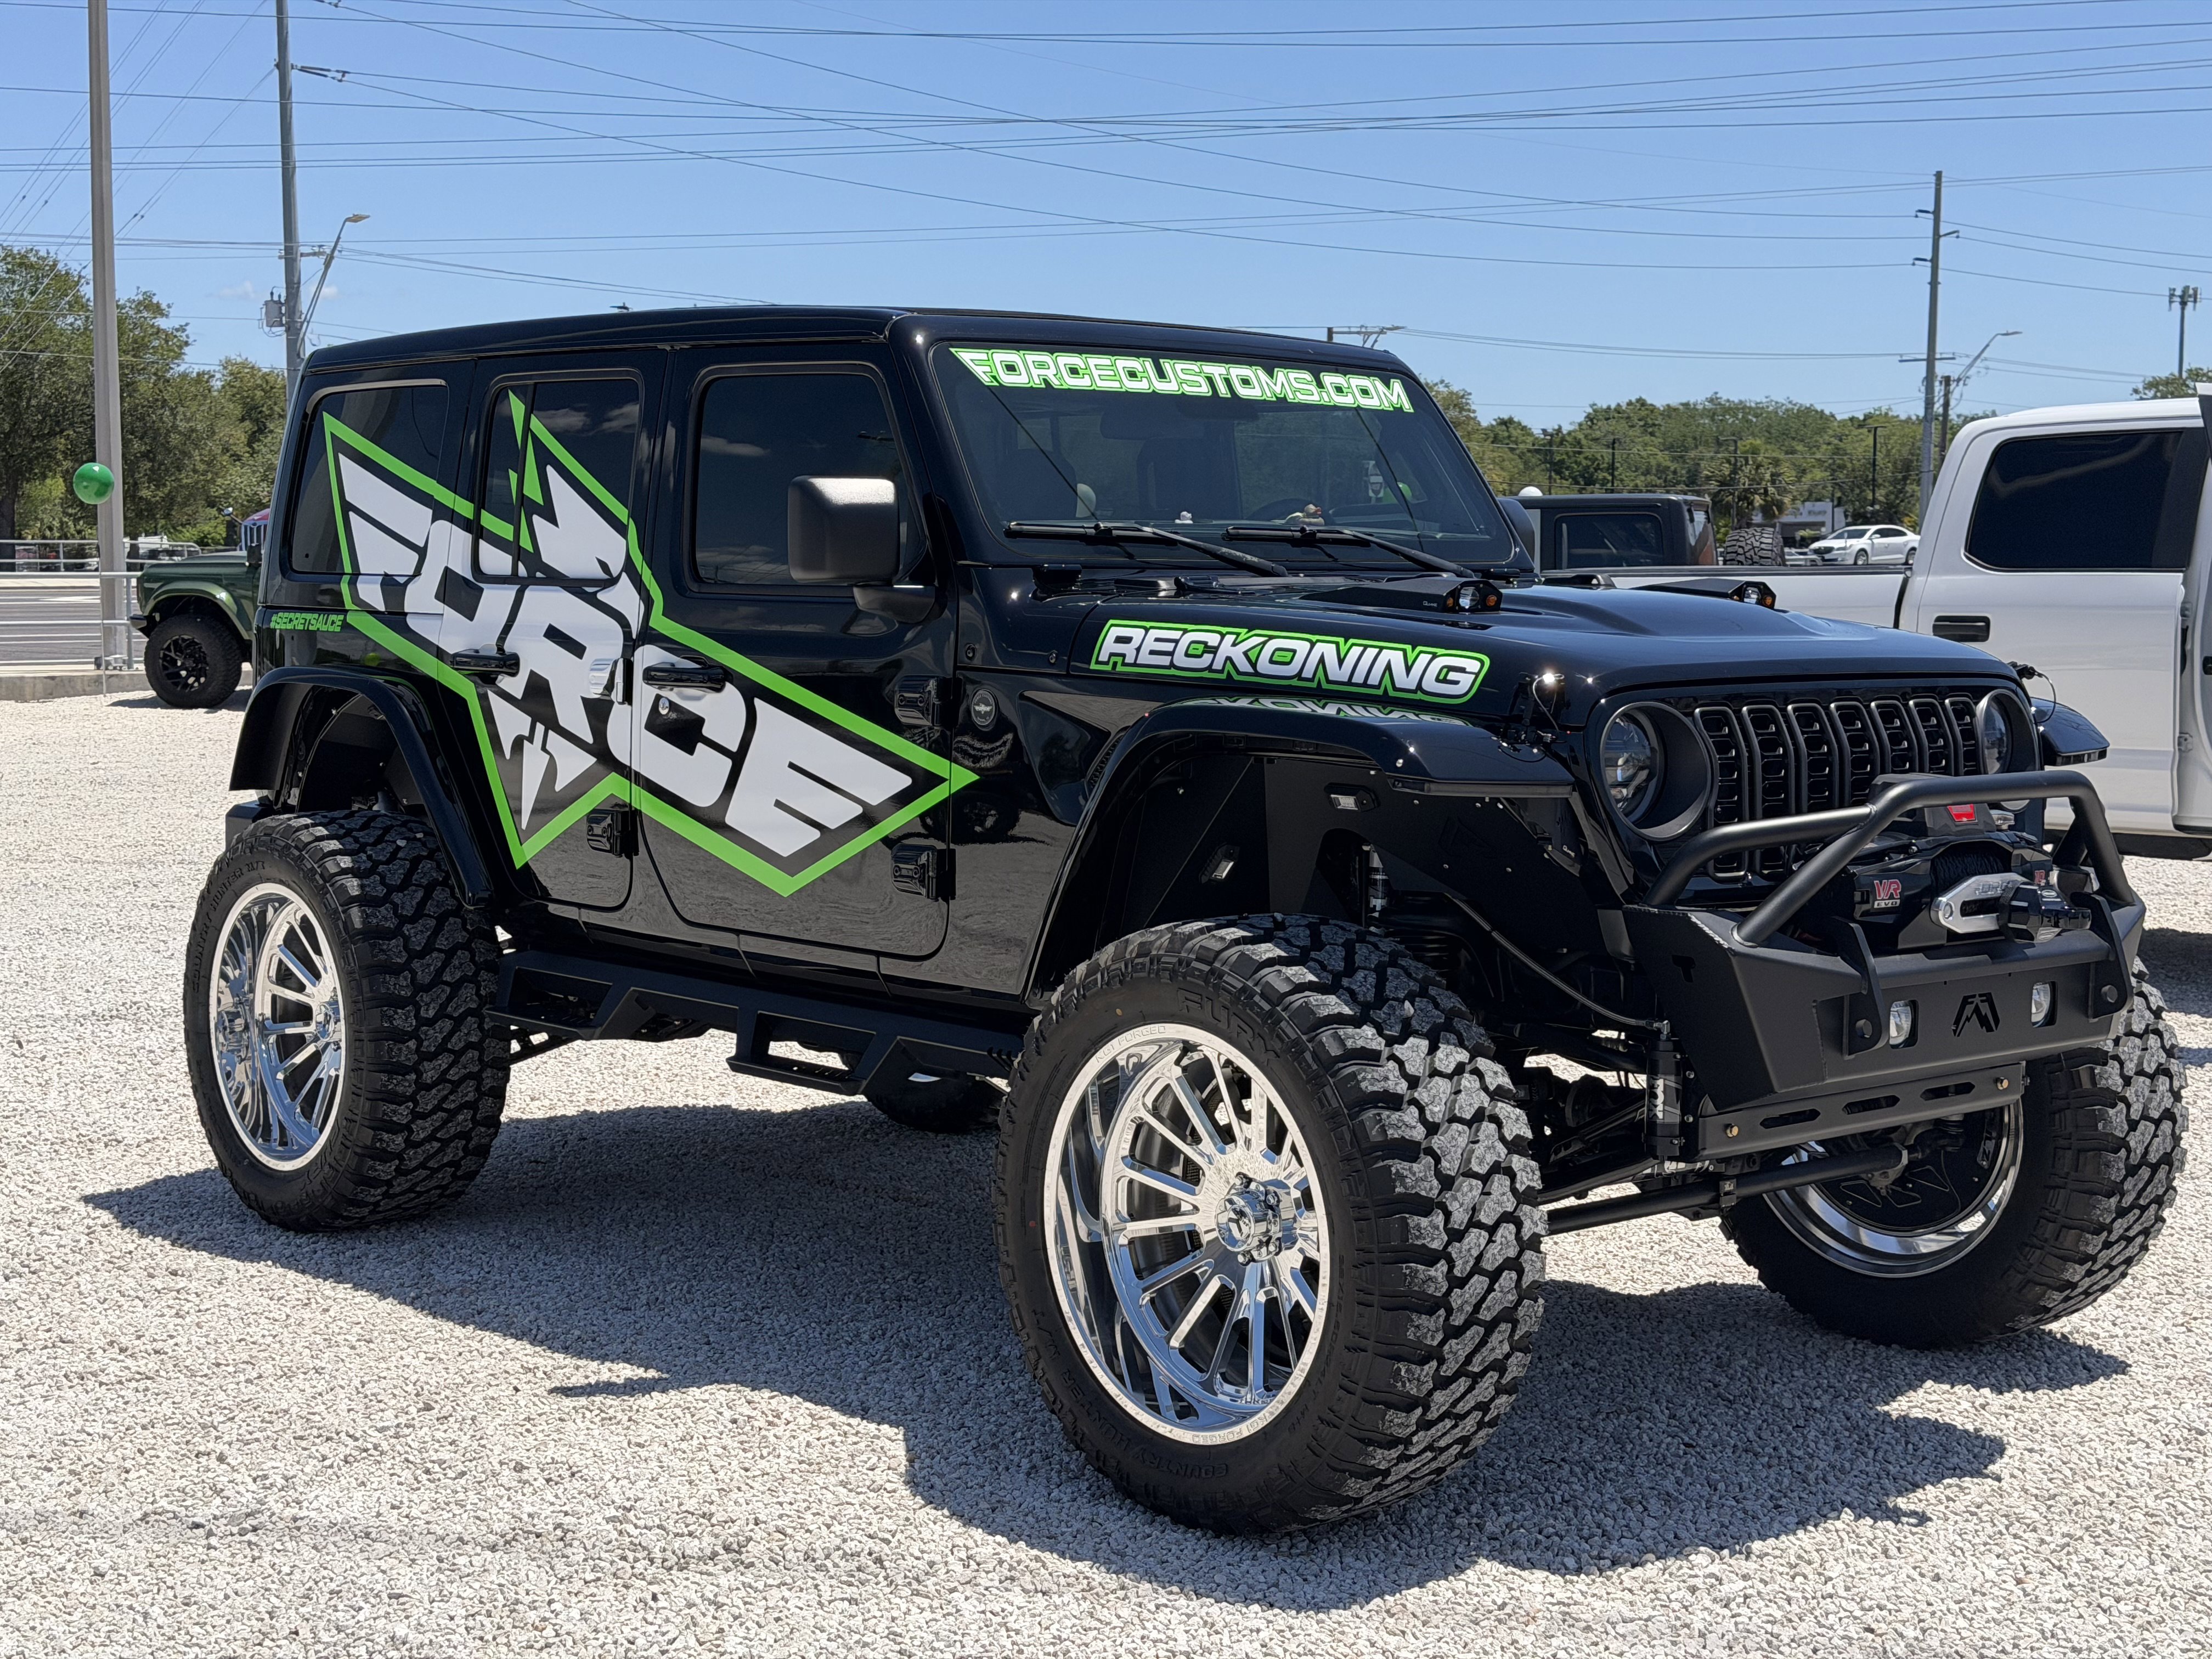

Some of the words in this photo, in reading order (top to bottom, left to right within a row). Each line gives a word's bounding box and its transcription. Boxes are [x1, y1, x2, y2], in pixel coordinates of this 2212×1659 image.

[950, 349, 1414, 412] FORCECUSTOMS.COM
[270, 612, 345, 632] #SECRETSAUCE
[338, 453, 912, 857] FORCE
[1093, 623, 1486, 699] RECKONING
[1874, 879, 1901, 899] VR
[1118, 1025, 1166, 1046] FORGED
[1177, 987, 1280, 1068] FURY
[1192, 1428, 1243, 1444] FORGED
